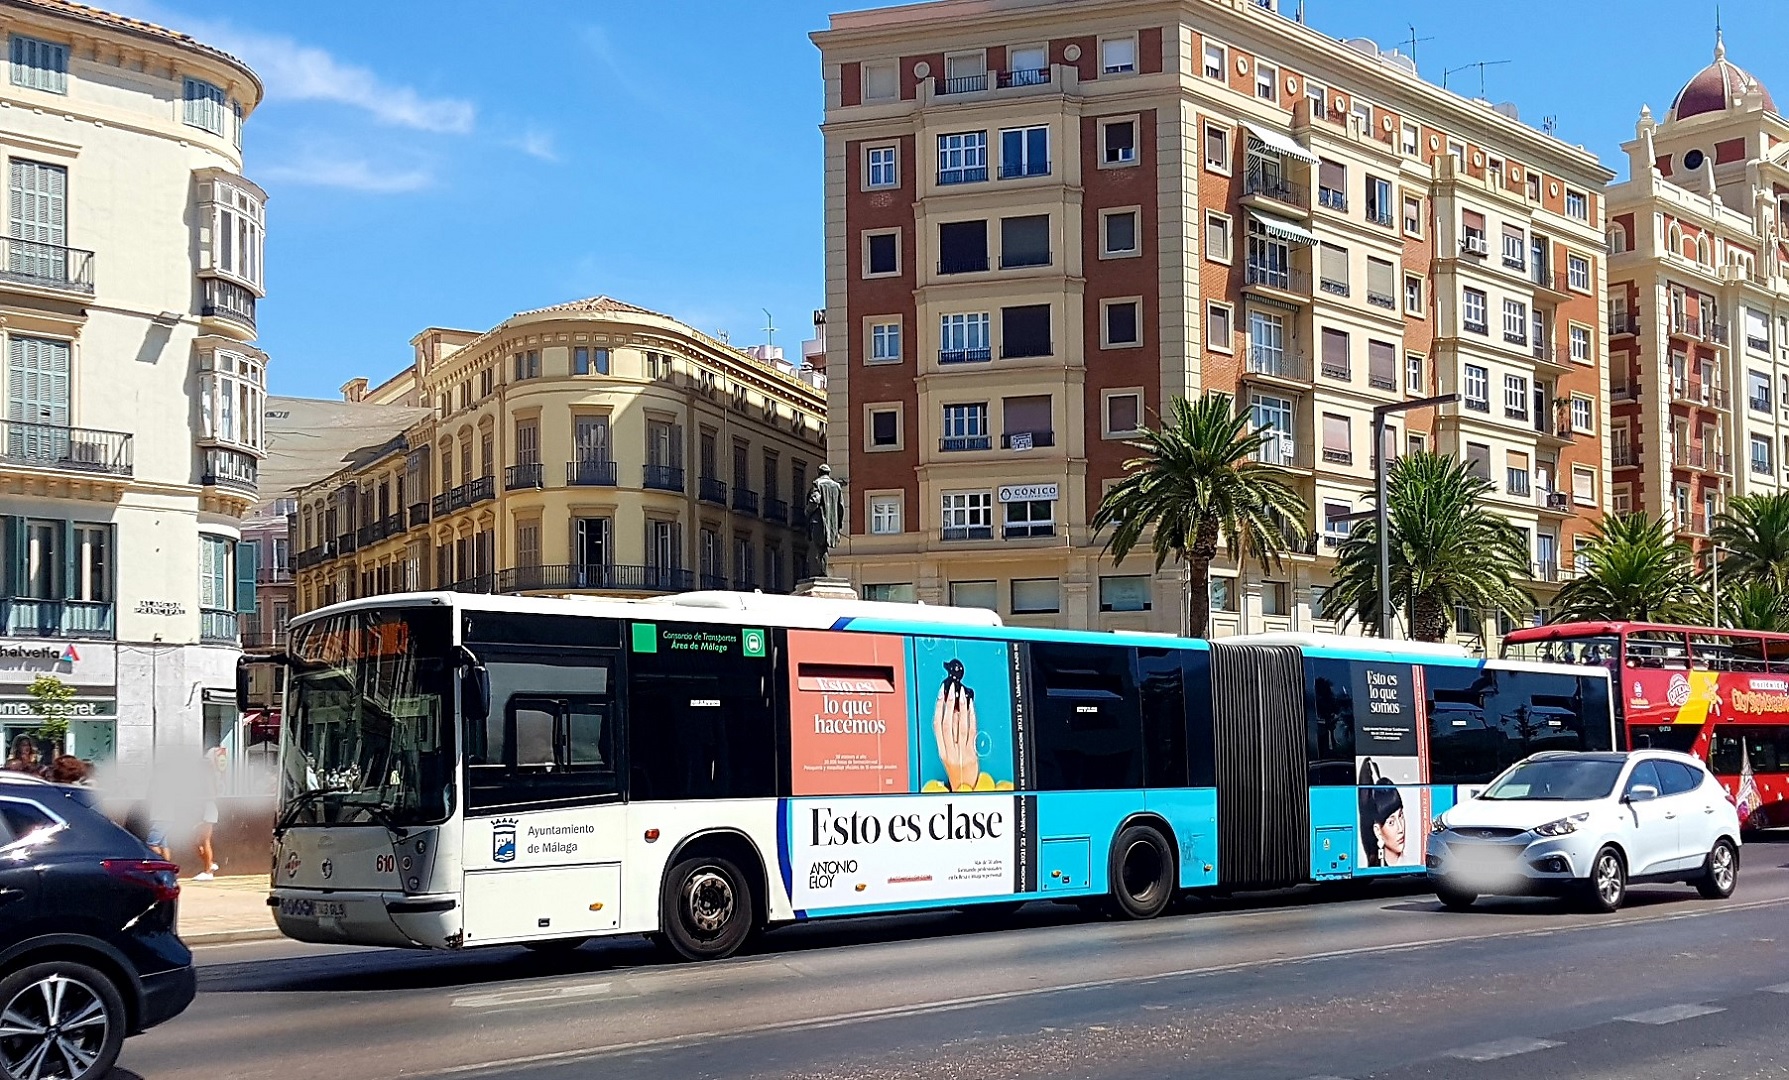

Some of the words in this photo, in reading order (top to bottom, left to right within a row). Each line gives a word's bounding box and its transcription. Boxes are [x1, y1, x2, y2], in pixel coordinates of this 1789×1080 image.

[662, 630, 693, 641] Consorcio
[693, 631, 702, 641] de
[702, 632, 737, 644] Transportes
[671, 639, 688, 650] Área
[690, 641, 698, 650] de
[700, 642, 728, 653] Málaga
[1366, 670, 1386, 685] Esto
[1386, 673, 1398, 686] es
[855, 681, 874, 696] es
[1369, 684, 1379, 699] lo
[1379, 687, 1398, 702] que
[823, 695, 840, 715] lo
[841, 699, 873, 720] que
[1370, 701, 1400, 714] somos
[814, 713, 887, 734] hacemos
[527, 823, 595, 838] Ayuntamiento
[809, 806, 882, 847] Esto
[888, 812, 922, 843] es
[928, 803, 1003, 841] clase
[527, 842, 540, 854] de
[542, 841, 578, 855] Málaga
[376, 854, 395, 872] 610
[809, 859, 858, 876] ANTONIO
[809, 874, 834, 890] ELOY
